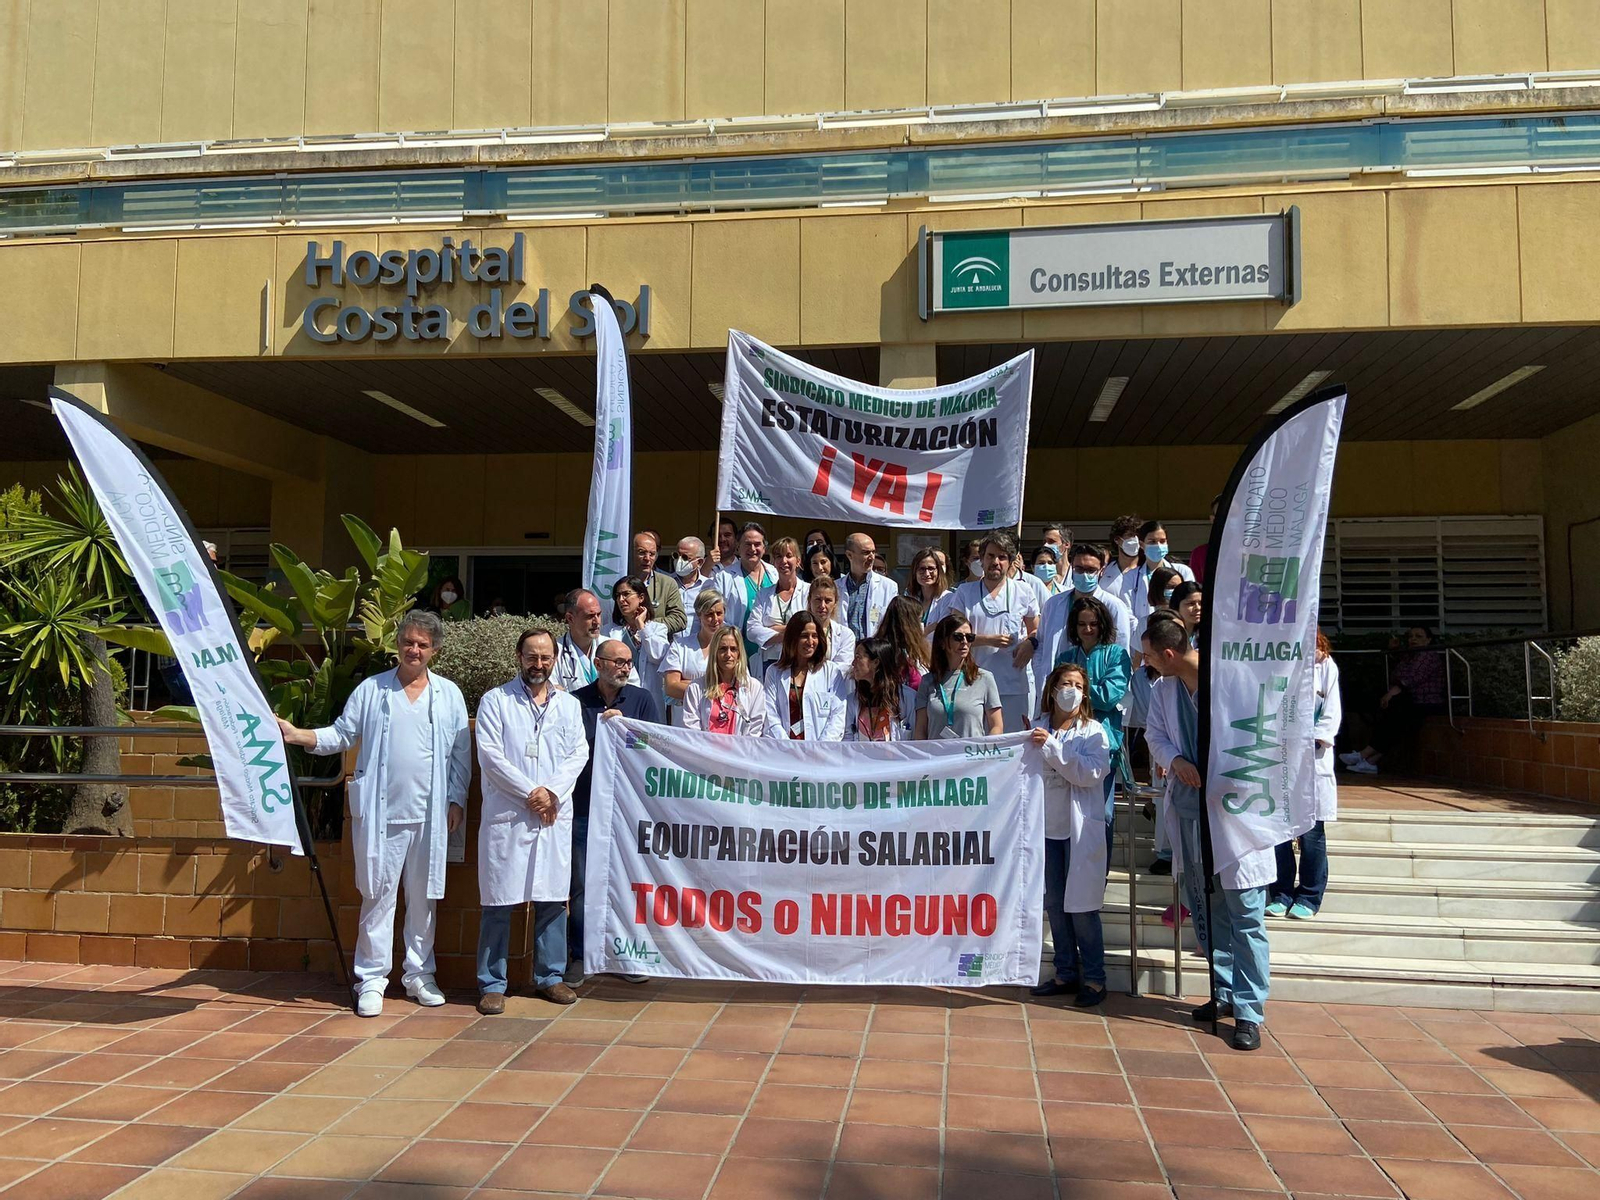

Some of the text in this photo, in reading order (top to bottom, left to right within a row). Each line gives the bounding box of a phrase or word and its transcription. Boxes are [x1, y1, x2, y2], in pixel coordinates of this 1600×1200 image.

[306, 232, 525, 297] Hospital
[1030, 260, 1271, 293] Consultas Externas
[302, 296, 452, 343] Costa
[468, 288, 551, 340] del
[763, 367, 845, 408] SINDICATO
[916, 398, 937, 418] DE
[939, 386, 998, 417] MÁLAGA
[761, 397, 998, 451] ESTATURIZACIÓN
[1242, 466, 1267, 549] SINDICATO
[1263, 487, 1288, 549] MÉDICO
[1288, 480, 1309, 548] MÁLAGA
[1221, 638, 1303, 662] MÁLAGA
[1280, 694, 1289, 731] Federación
[1288, 695, 1296, 723] Málaga
[1280, 738, 1288, 765] Andaluz
[644, 766, 989, 809] SINDICATO MÉDICO DE MÁLAGA
[1281, 791, 1291, 823] Sindicato
[637, 820, 995, 866] EQUIPARACIÓN SALARIAL
[631, 882, 763, 935] TODOS
[811, 893, 997, 937] NINGUNO
[613, 937, 658, 959] SMA
